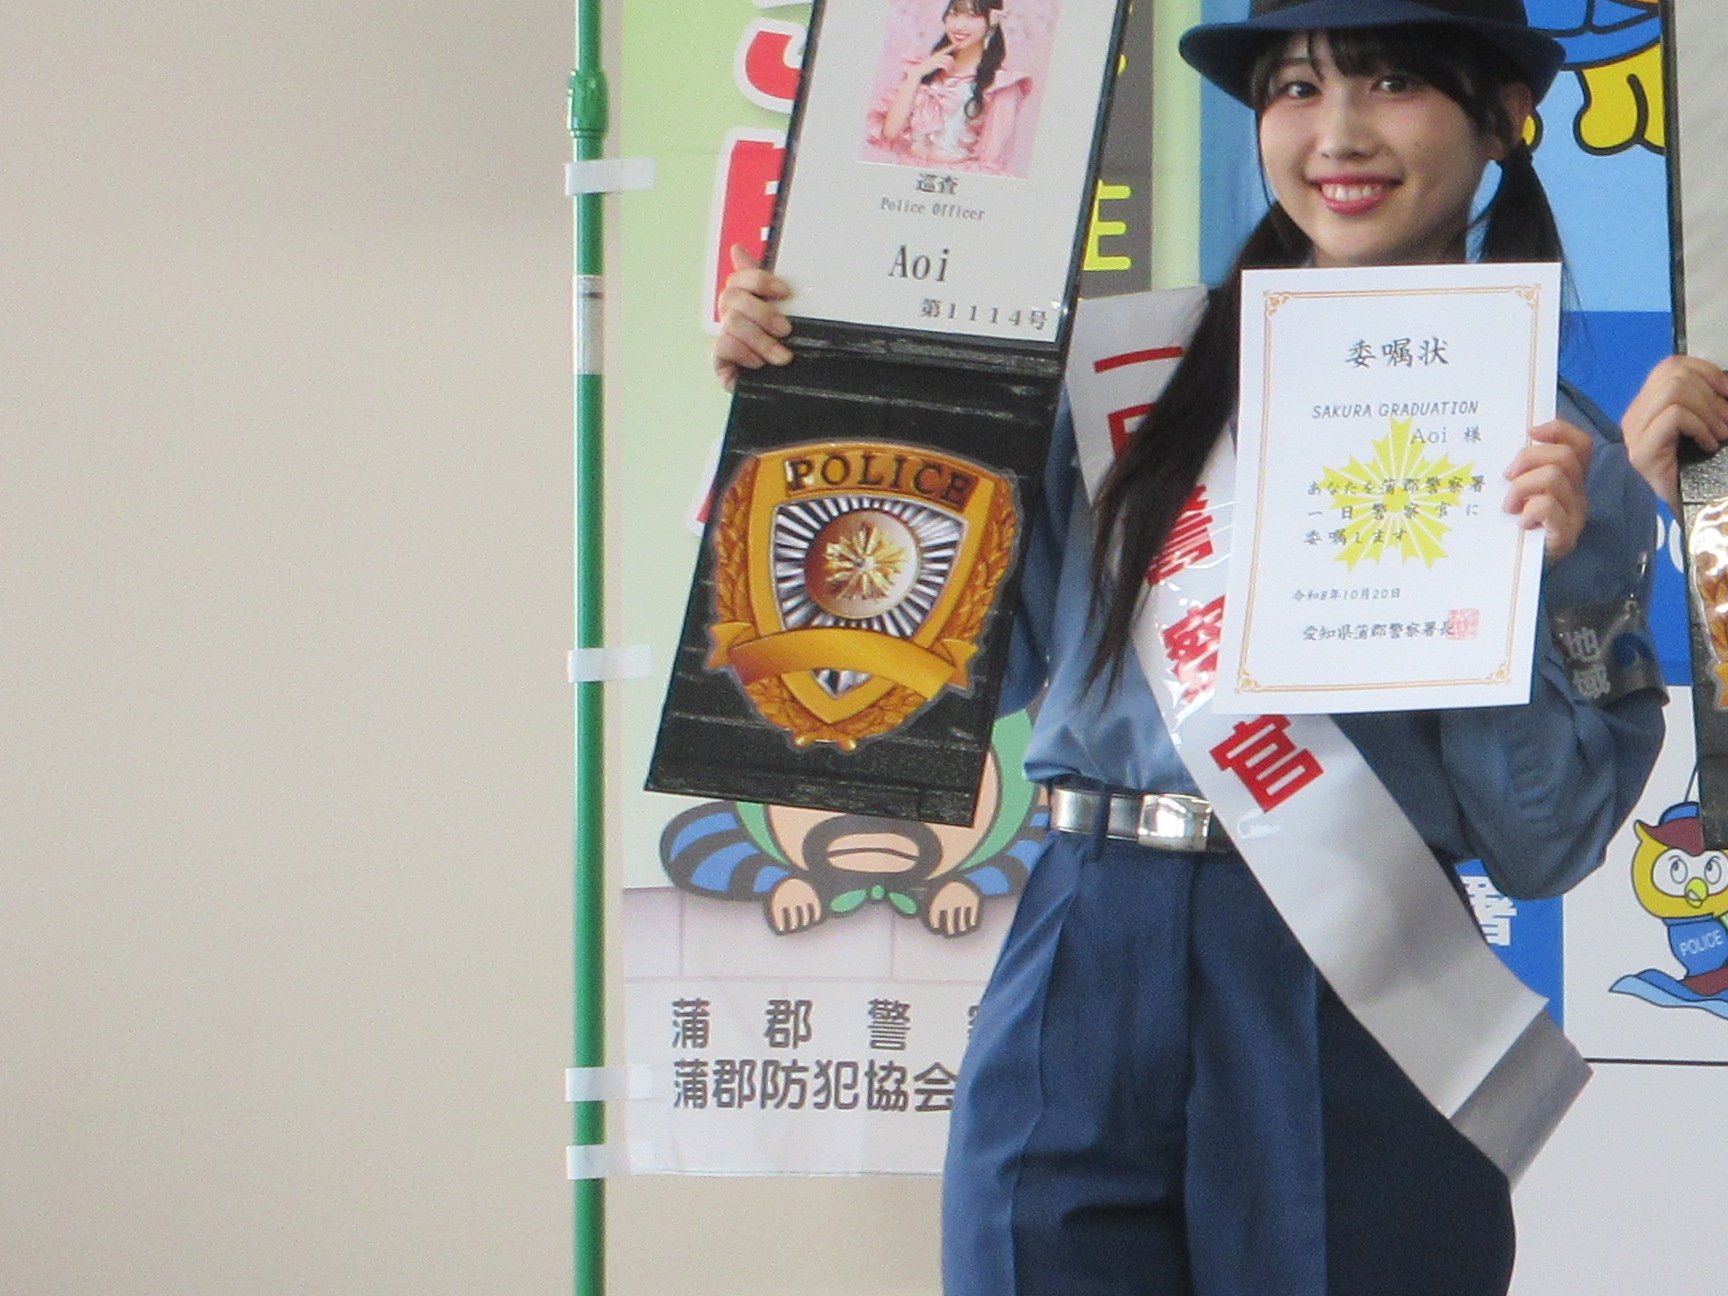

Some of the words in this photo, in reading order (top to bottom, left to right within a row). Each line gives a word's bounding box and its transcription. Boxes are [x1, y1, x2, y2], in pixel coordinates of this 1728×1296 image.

[915, 172, 958, 196] 巡査
[880, 197, 925, 218] Police
[930, 203, 985, 222] Officer
[888, 244, 950, 284] Aoi
[921, 298, 1048, 332] 第1114号
[1346, 337, 1449, 368] 委嘱状
[1313, 404, 1372, 419] SAKURA
[1378, 400, 1479, 417] GRADUATION
[1411, 426, 1447, 445] Aoi
[1463, 426, 1481, 443] 様
[785, 448, 978, 512] POLICE
[1679, 929, 1724, 957] POLICE
[671, 997, 980, 1052] 蒲郡警
[672, 1059, 956, 1113] 蒲郡防犯協会
